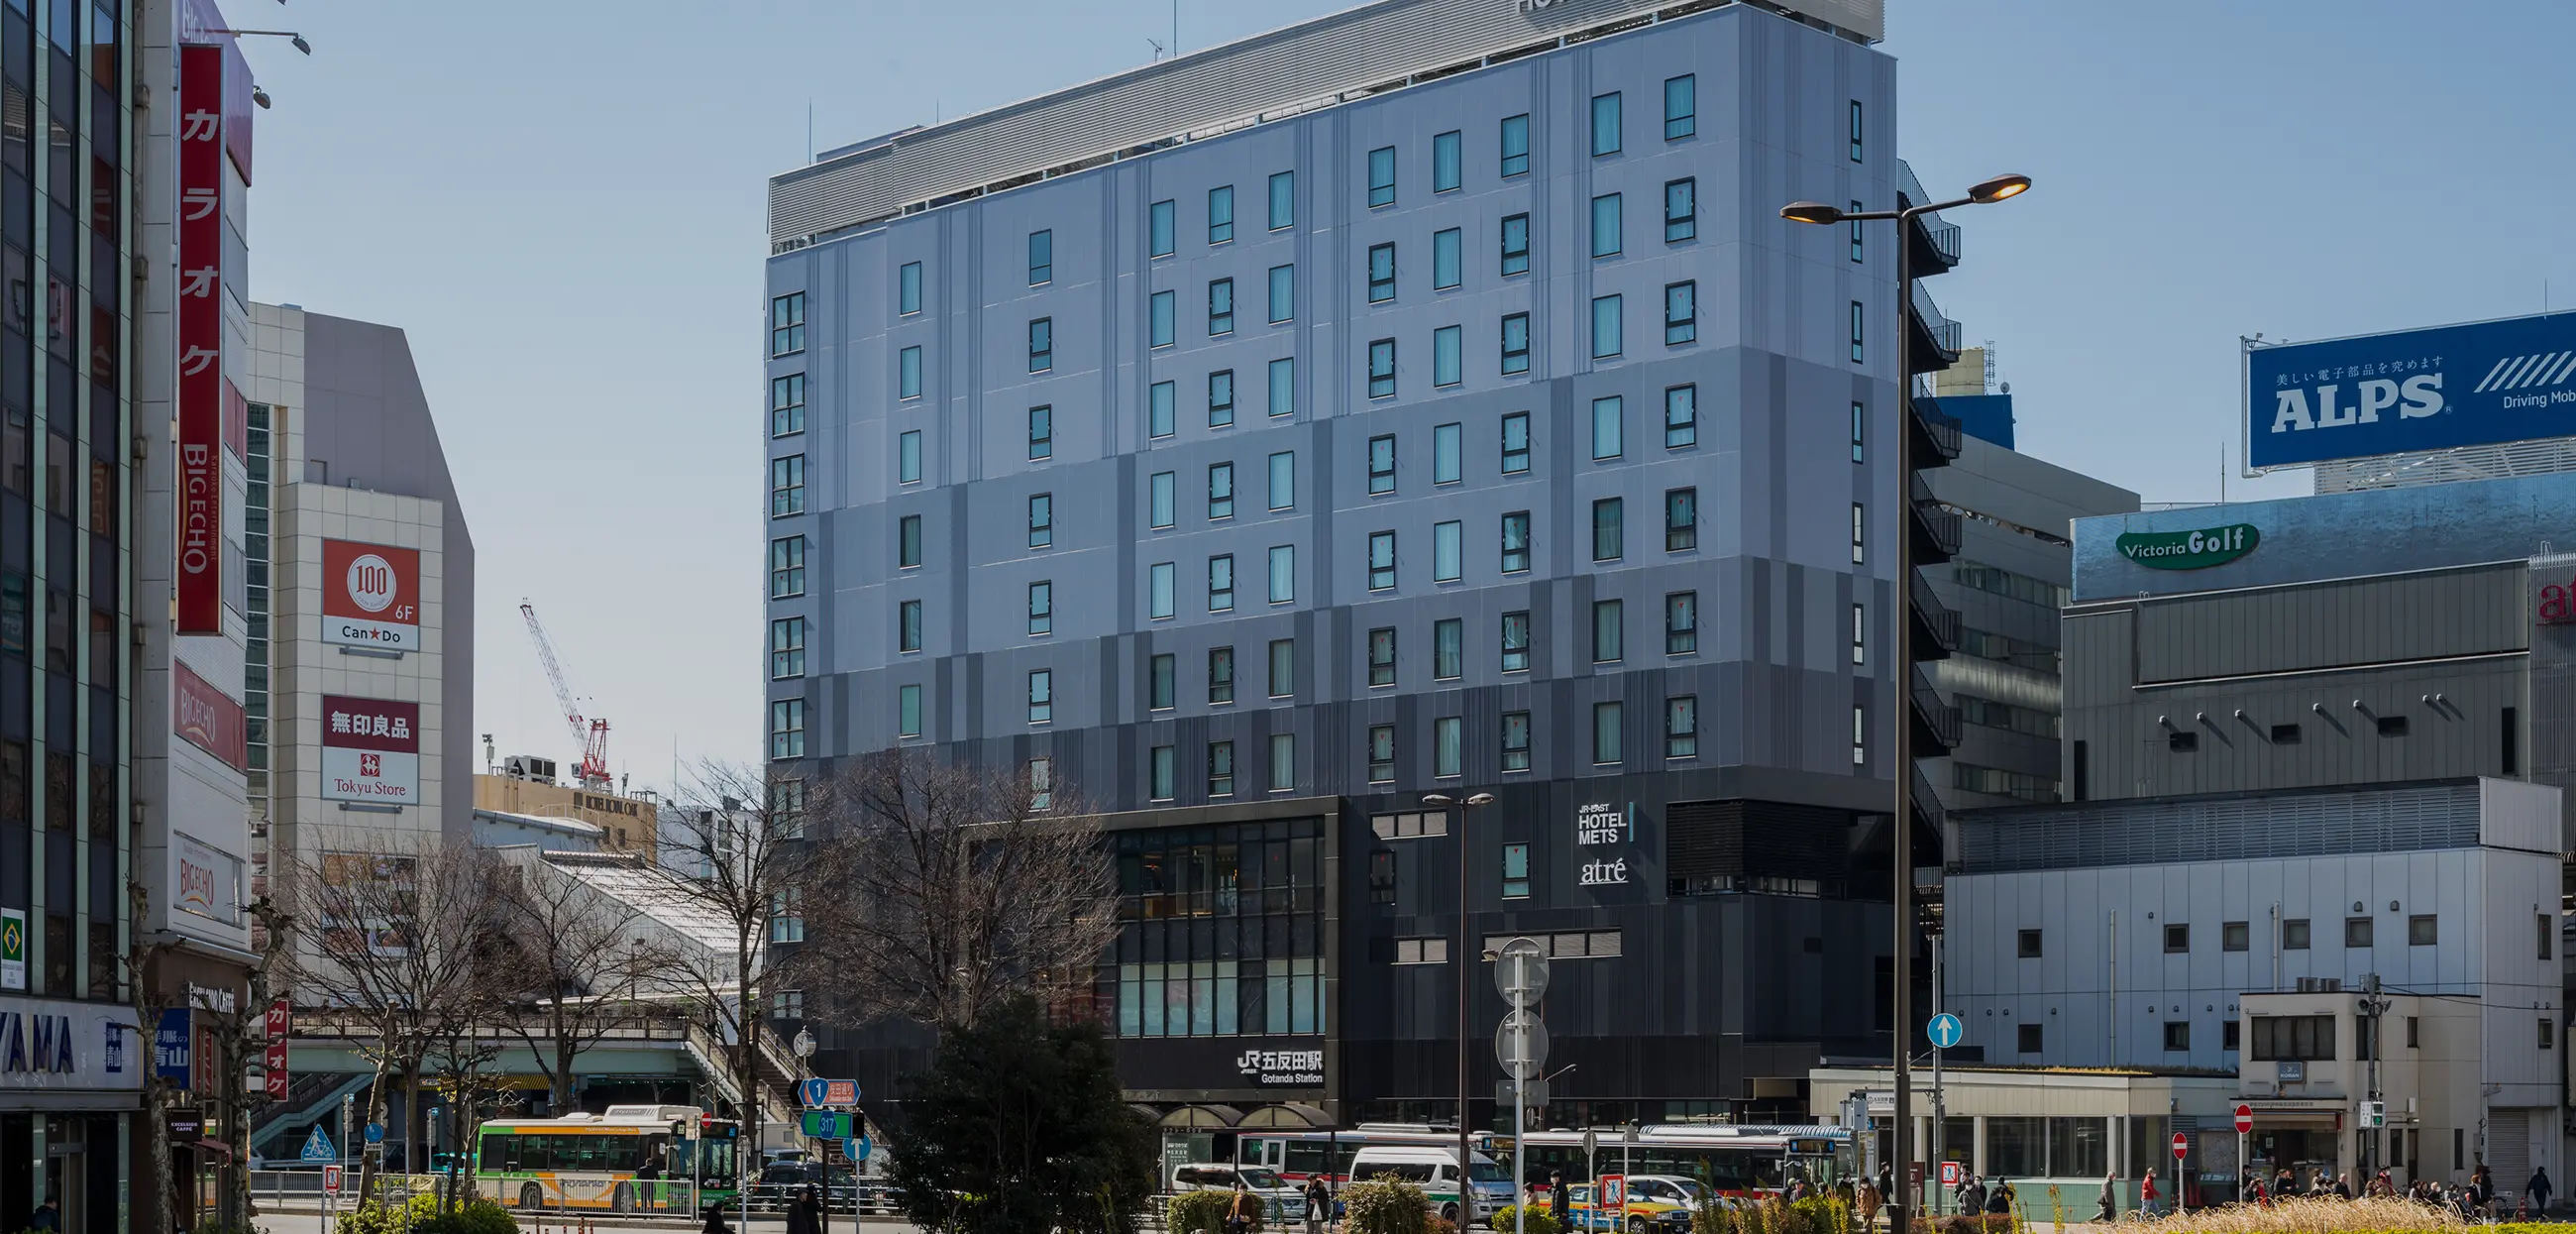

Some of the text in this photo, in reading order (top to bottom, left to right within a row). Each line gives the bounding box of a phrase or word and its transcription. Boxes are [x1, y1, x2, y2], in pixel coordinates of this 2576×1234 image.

[179, 108, 220, 377] カラオケ
[2276, 355, 2443, 386] 美しい電子部品を究めます
[2272, 373, 2444, 433] ALPS
[2504, 393, 2547, 408] Driving
[183, 444, 208, 574] BIG ECHO
[2125, 527, 2244, 558] Victoria Golf
[357, 564, 387, 596] 100
[395, 605, 413, 620] 6F
[342, 625, 400, 642] Can Do
[181, 687, 196, 726] BIG
[195, 700, 216, 742] ECHO
[331, 710, 410, 739] 無印良品
[334, 778, 406, 797] Tokyu Store
[1578, 812, 1627, 830] HOTEL
[1578, 828, 1618, 844] METS
[1580, 857, 1627, 883] atré
[180, 857, 214, 906] BIG ECHO
[0, 1012, 75, 1073] AMA
[107, 1045, 121, 1067] 青山
[1237, 1051, 1262, 1068] JR
[1261, 1051, 1324, 1070] 五反田駅
[1261, 1073, 1323, 1083] Gotanda Station
[815, 1082, 821, 1098] 1
[819, 1117, 834, 1132] 317
